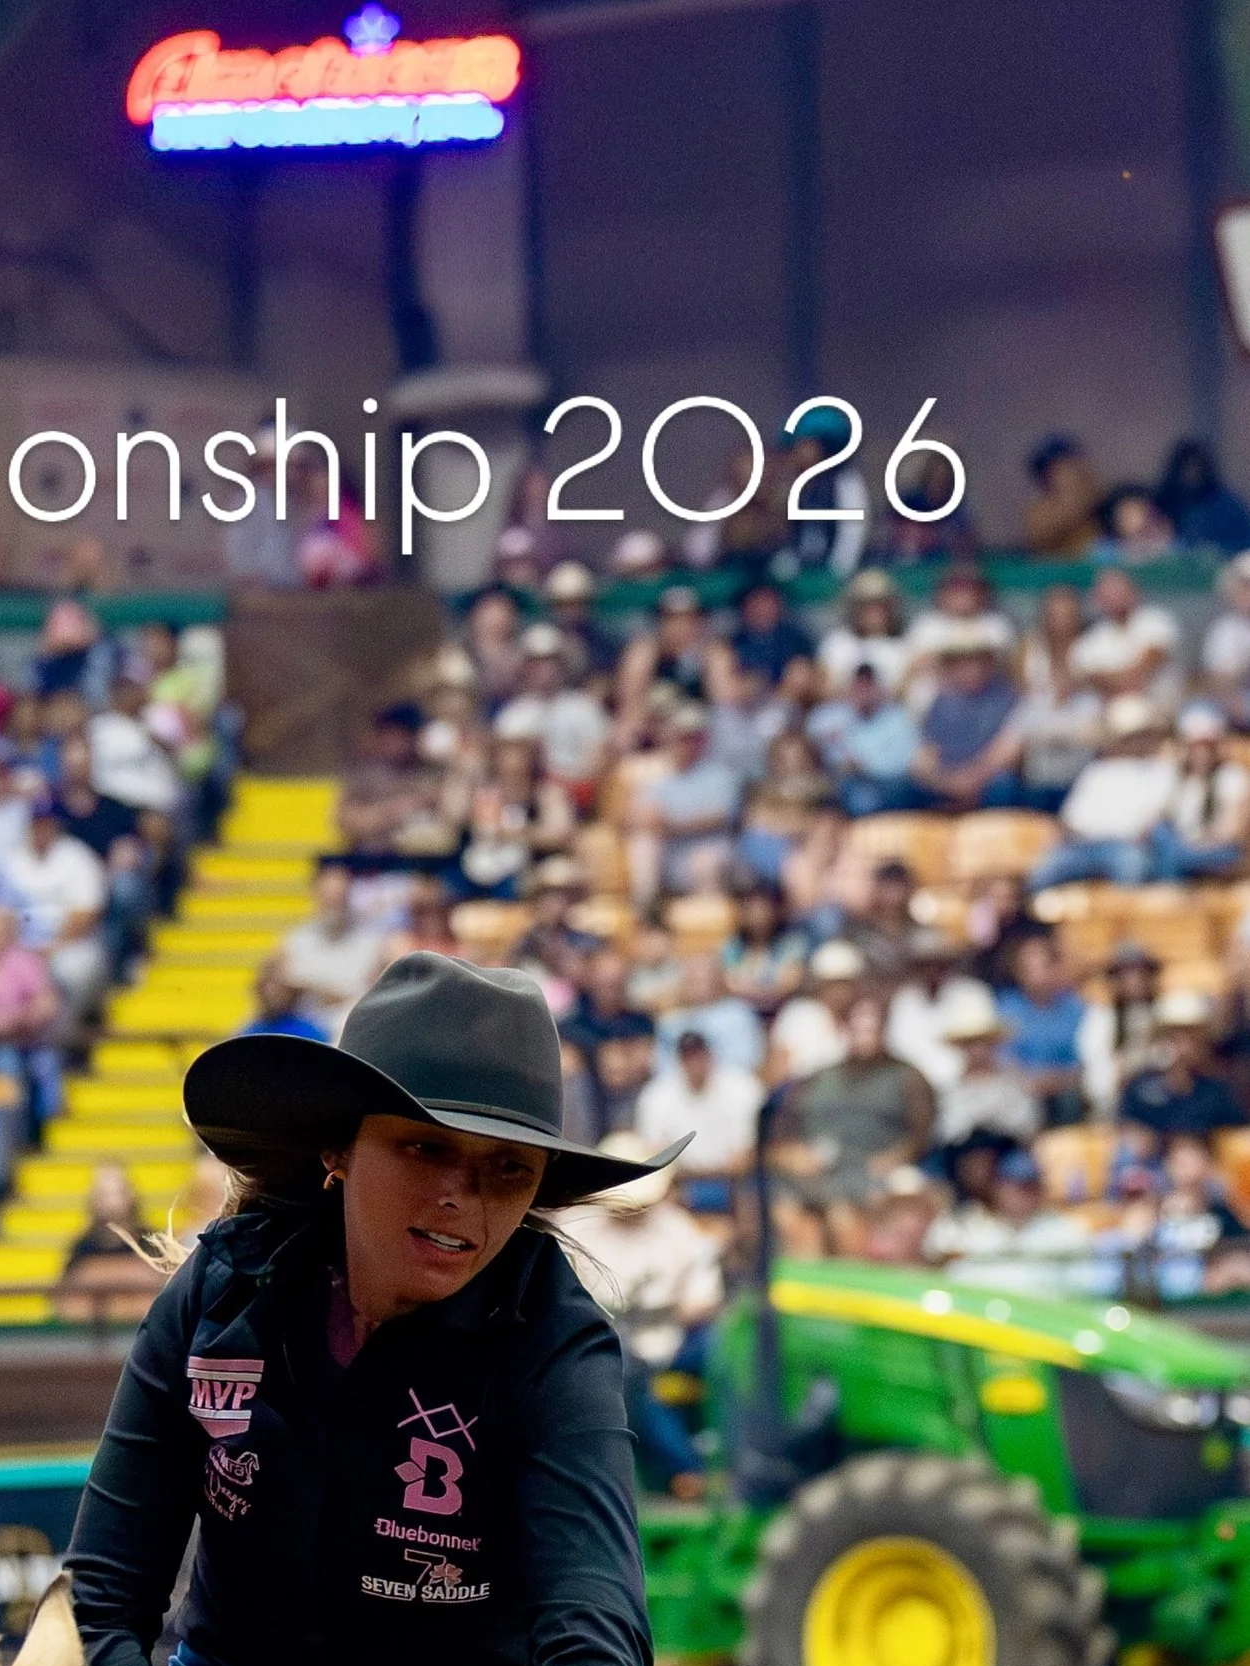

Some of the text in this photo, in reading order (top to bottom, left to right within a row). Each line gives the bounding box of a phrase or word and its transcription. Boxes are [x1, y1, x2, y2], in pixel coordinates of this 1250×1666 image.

[190, 1379, 257, 1410] MVP
[374, 1517, 480, 1551] Bluebonnet
[361, 1575, 491, 1600] SEVEN SADDLE
